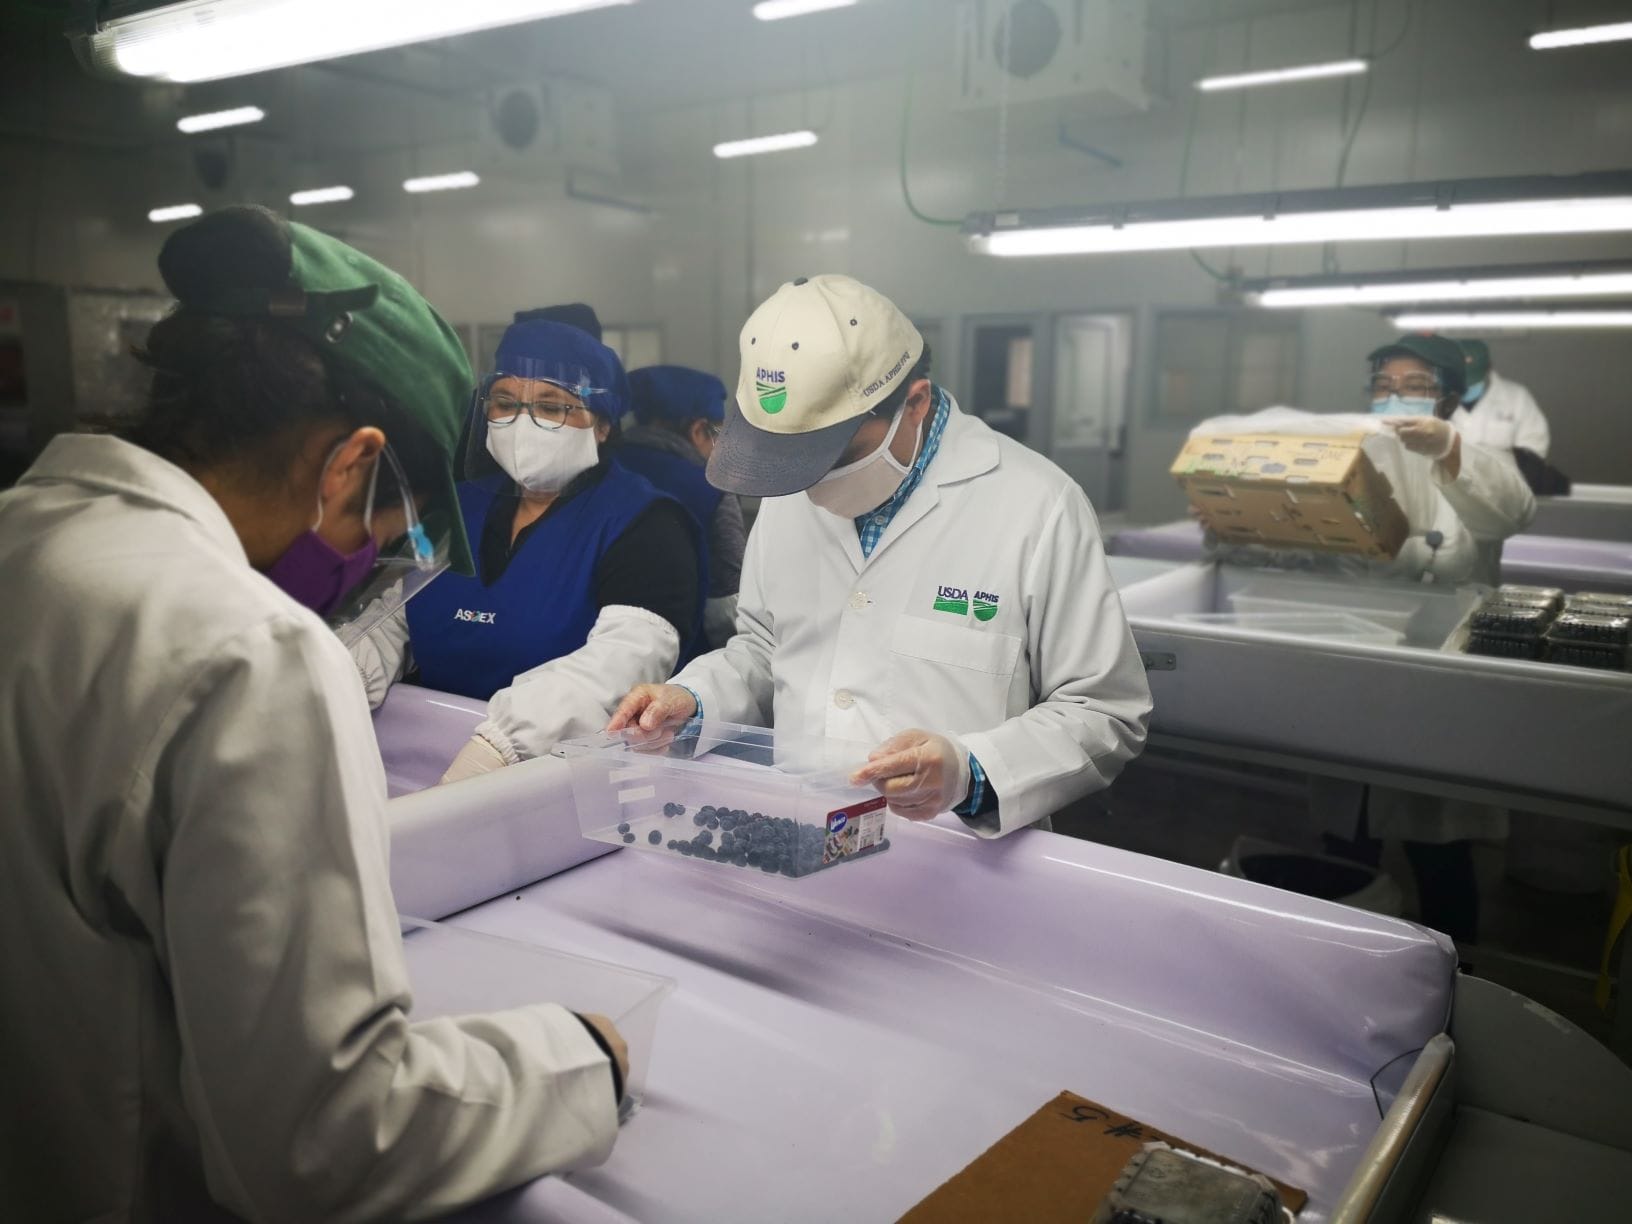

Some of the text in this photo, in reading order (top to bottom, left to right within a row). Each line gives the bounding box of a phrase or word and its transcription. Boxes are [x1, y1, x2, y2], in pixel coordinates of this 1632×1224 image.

[756, 367, 785, 383] APHIS
[863, 380, 885, 397] USDA
[938, 585, 999, 603] USDA APHIS
